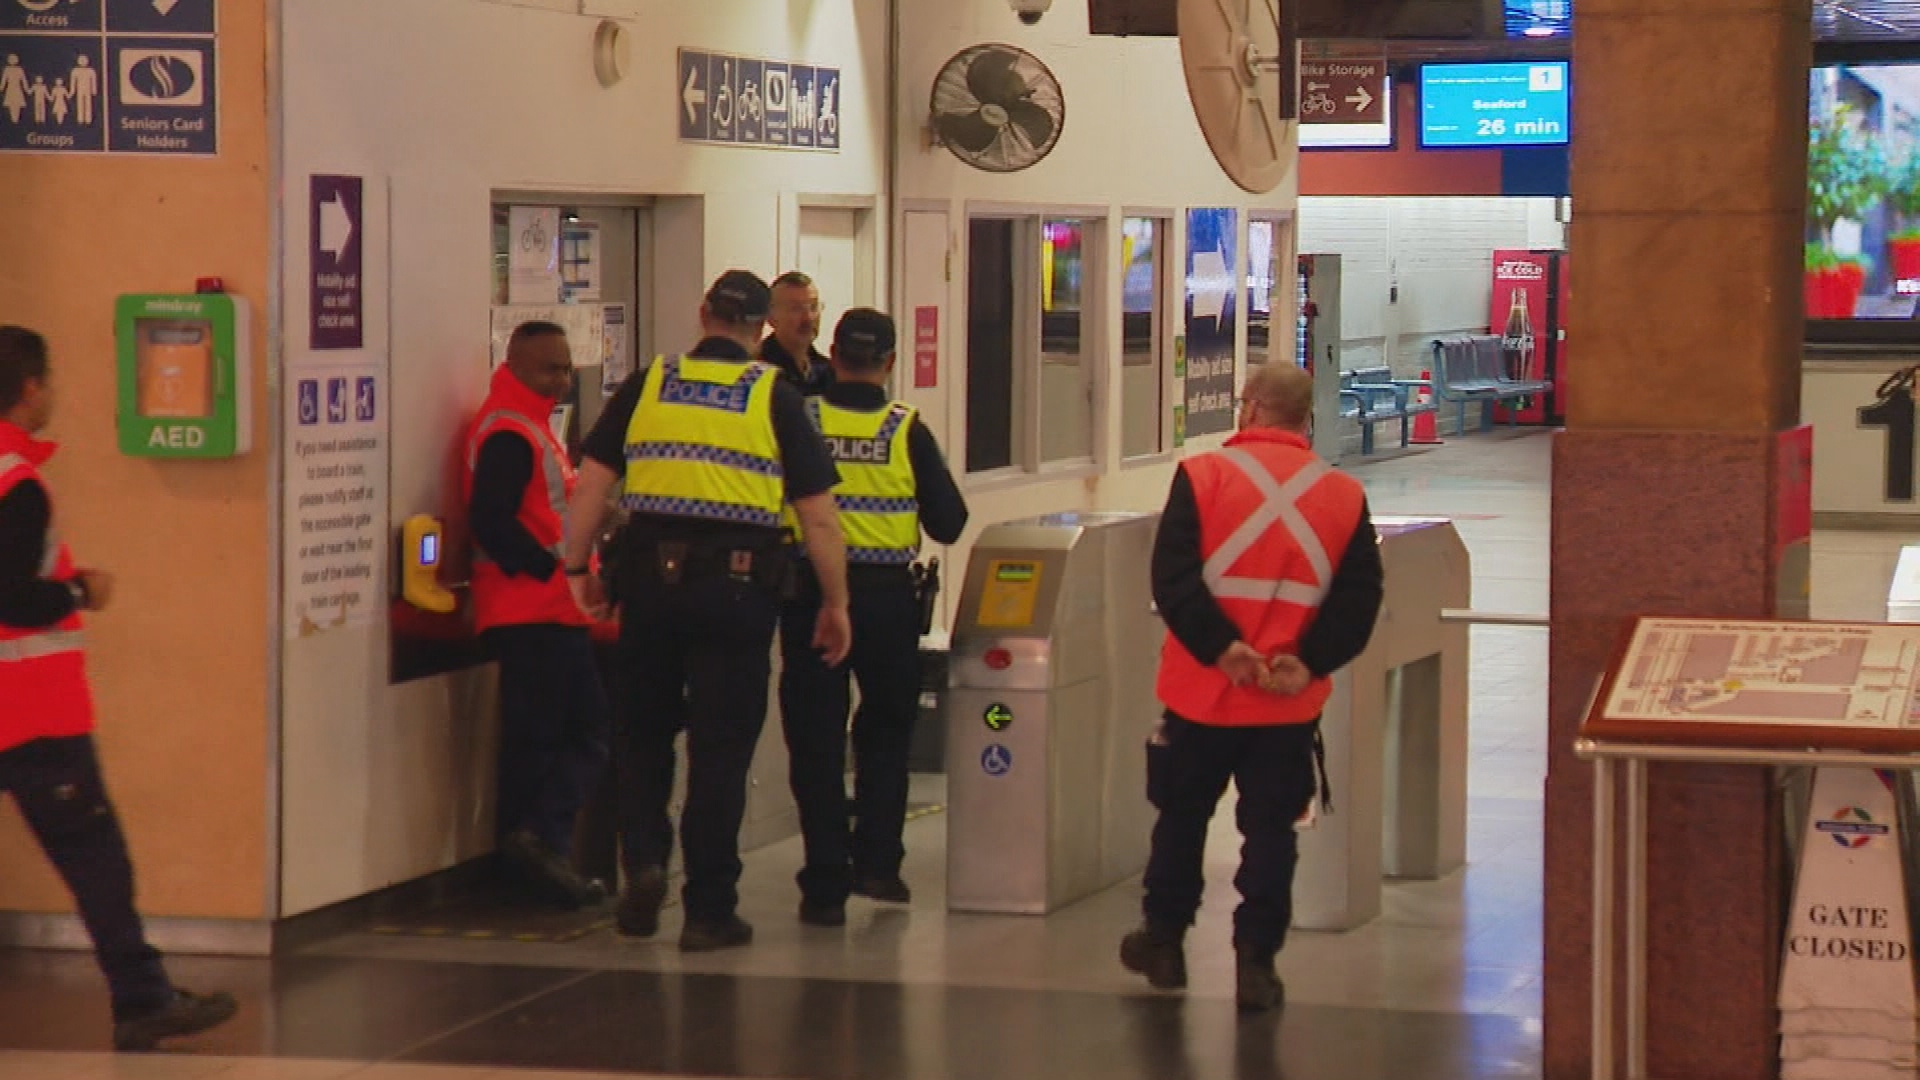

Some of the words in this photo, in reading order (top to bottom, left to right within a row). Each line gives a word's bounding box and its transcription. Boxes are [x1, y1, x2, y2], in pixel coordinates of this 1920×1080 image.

[26, 14, 69, 26] Access
[1301, 64, 1325, 76] Bike
[1328, 64, 1375, 78] Storage
[1541, 71, 1549, 84] 1
[1472, 99, 1527, 110] Seaford
[121, 117, 169, 131] Seniors
[173, 117, 203, 131] Card
[1476, 118, 1506, 136] 26
[1514, 118, 1560, 135] min
[26, 132, 74, 146] Groups
[137, 135, 188, 148] Holders
[664, 381, 745, 411] POLICE
[149, 426, 206, 448] AED
[1857, 385, 1915, 502] 1
[824, 437, 888, 461] OLICE
[1810, 904, 1889, 929] GATE
[1791, 936, 1906, 961] CLOSED
